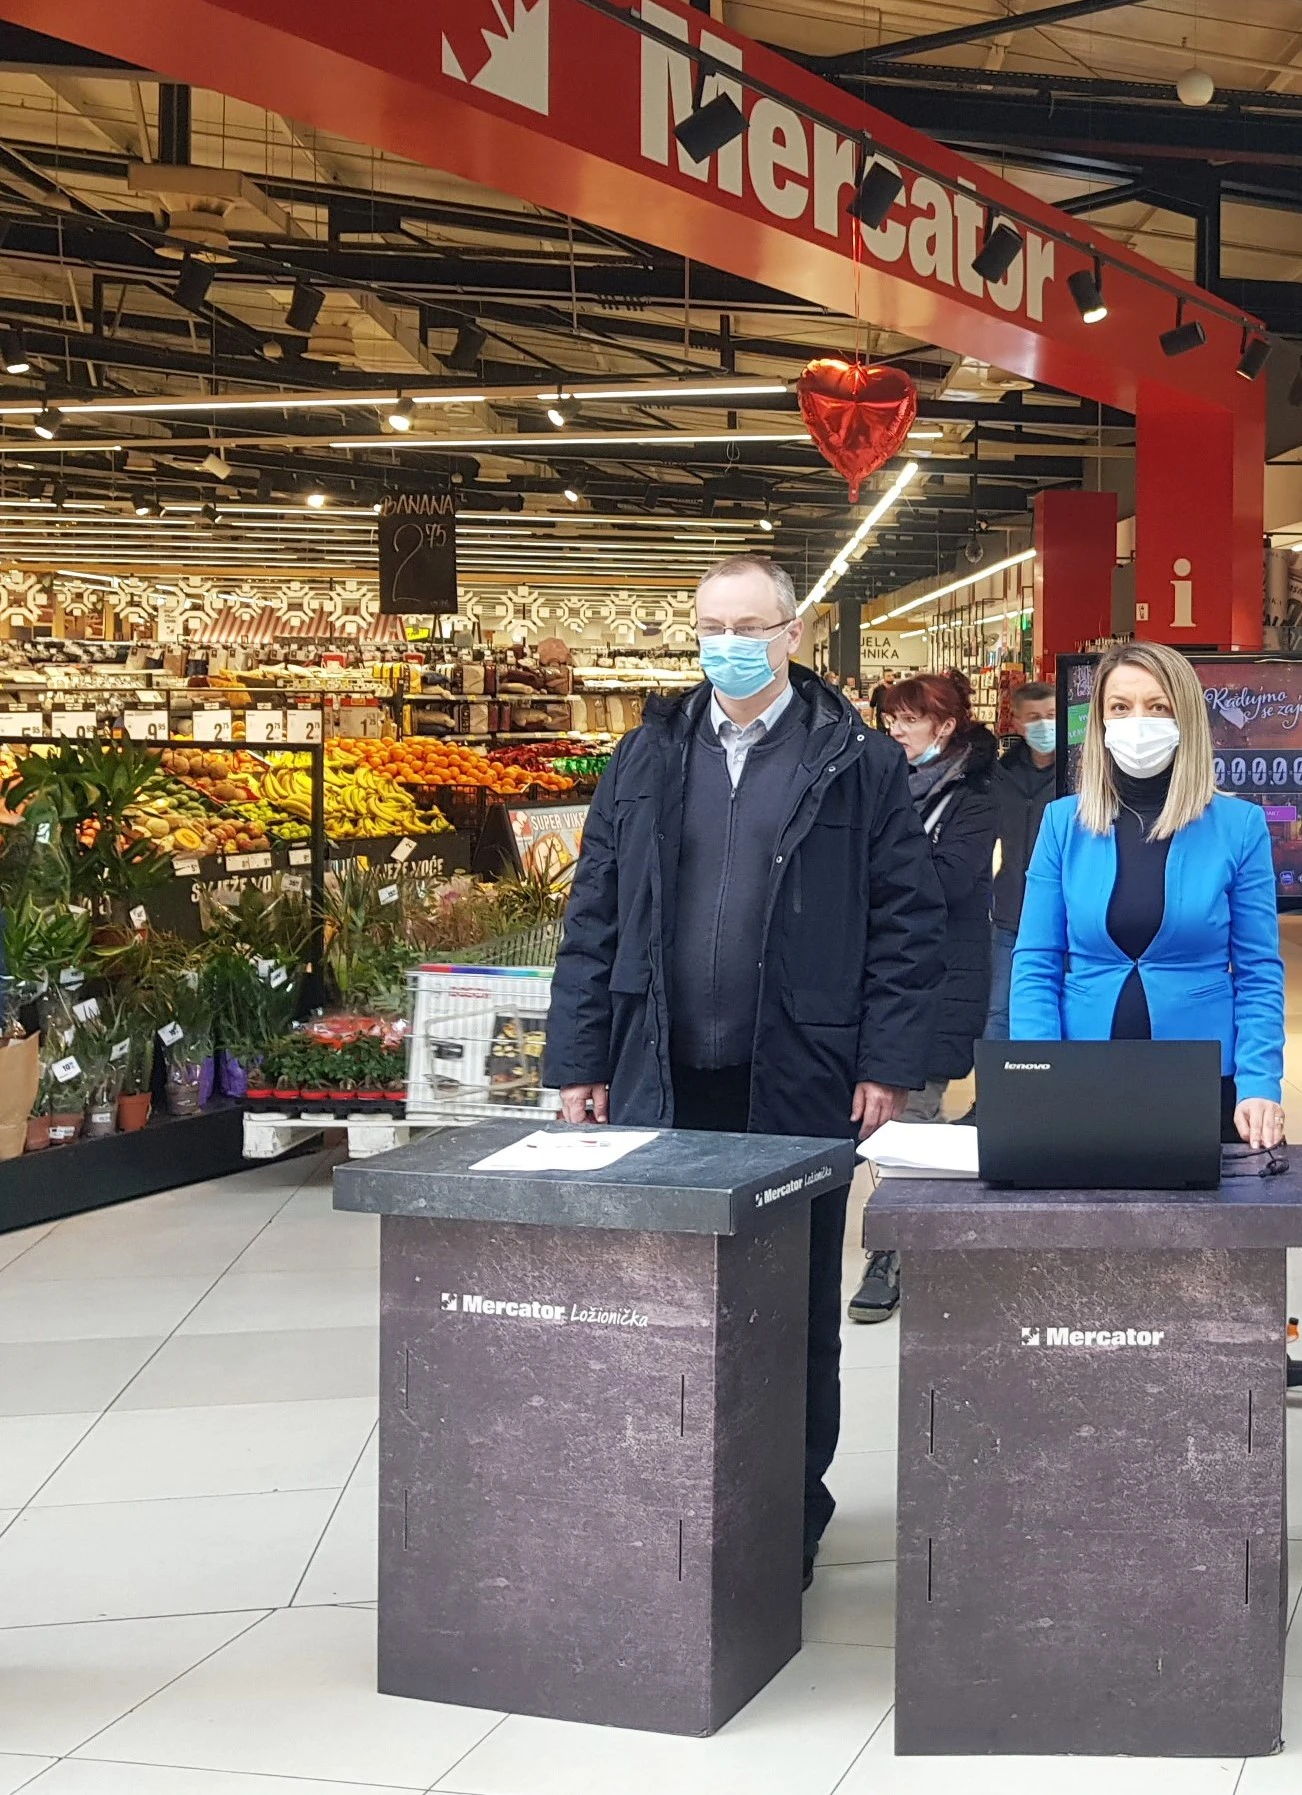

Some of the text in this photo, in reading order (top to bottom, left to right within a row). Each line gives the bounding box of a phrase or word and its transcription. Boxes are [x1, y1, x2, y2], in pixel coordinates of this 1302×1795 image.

[380, 494, 454, 516] BANANA
[1203, 686, 1287, 722] Radujmo
[531, 814, 561, 831] SUPER
[1003, 1061, 1051, 1070] lenovo
[763, 1178, 803, 1204] Mercator
[462, 1294, 649, 1327] Mercator Ložionička
[1046, 1327, 1165, 1346] Mercator
